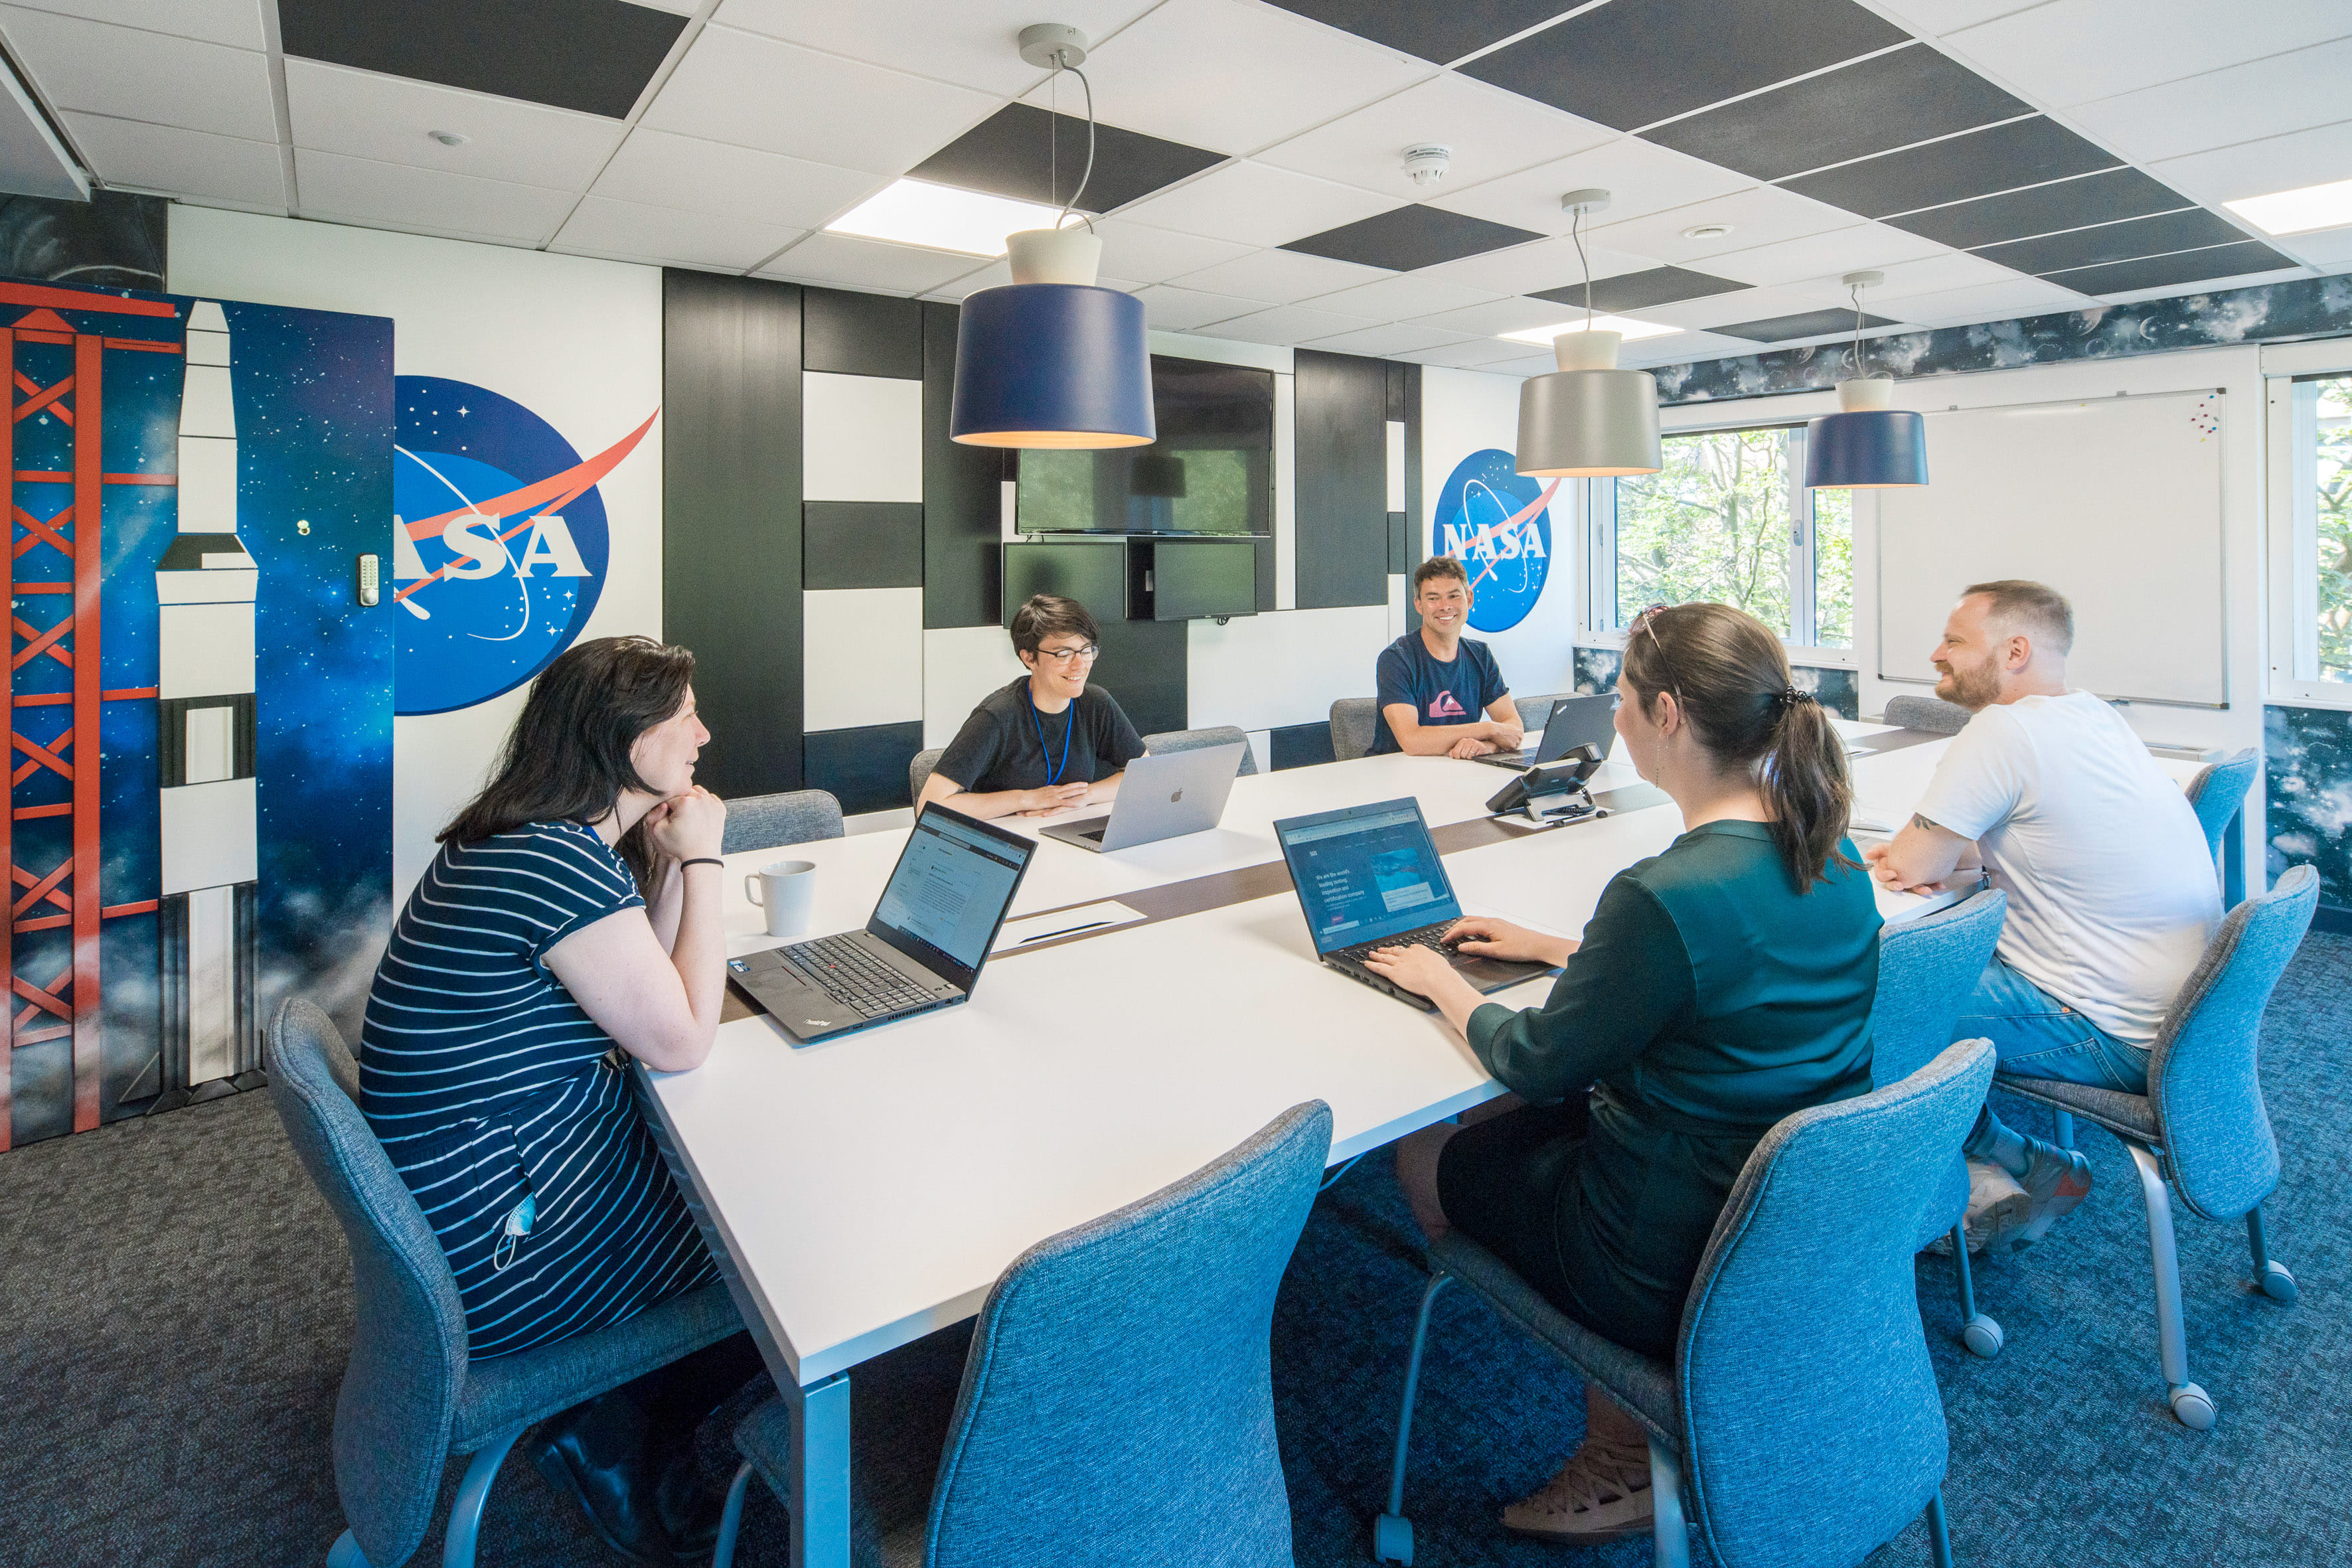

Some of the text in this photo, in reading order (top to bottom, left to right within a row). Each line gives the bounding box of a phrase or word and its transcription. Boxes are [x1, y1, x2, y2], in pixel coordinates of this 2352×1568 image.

[394, 511, 593, 583] ASA
[1442, 522, 1547, 561] NASA
[1324, 894, 1348, 903] certification
